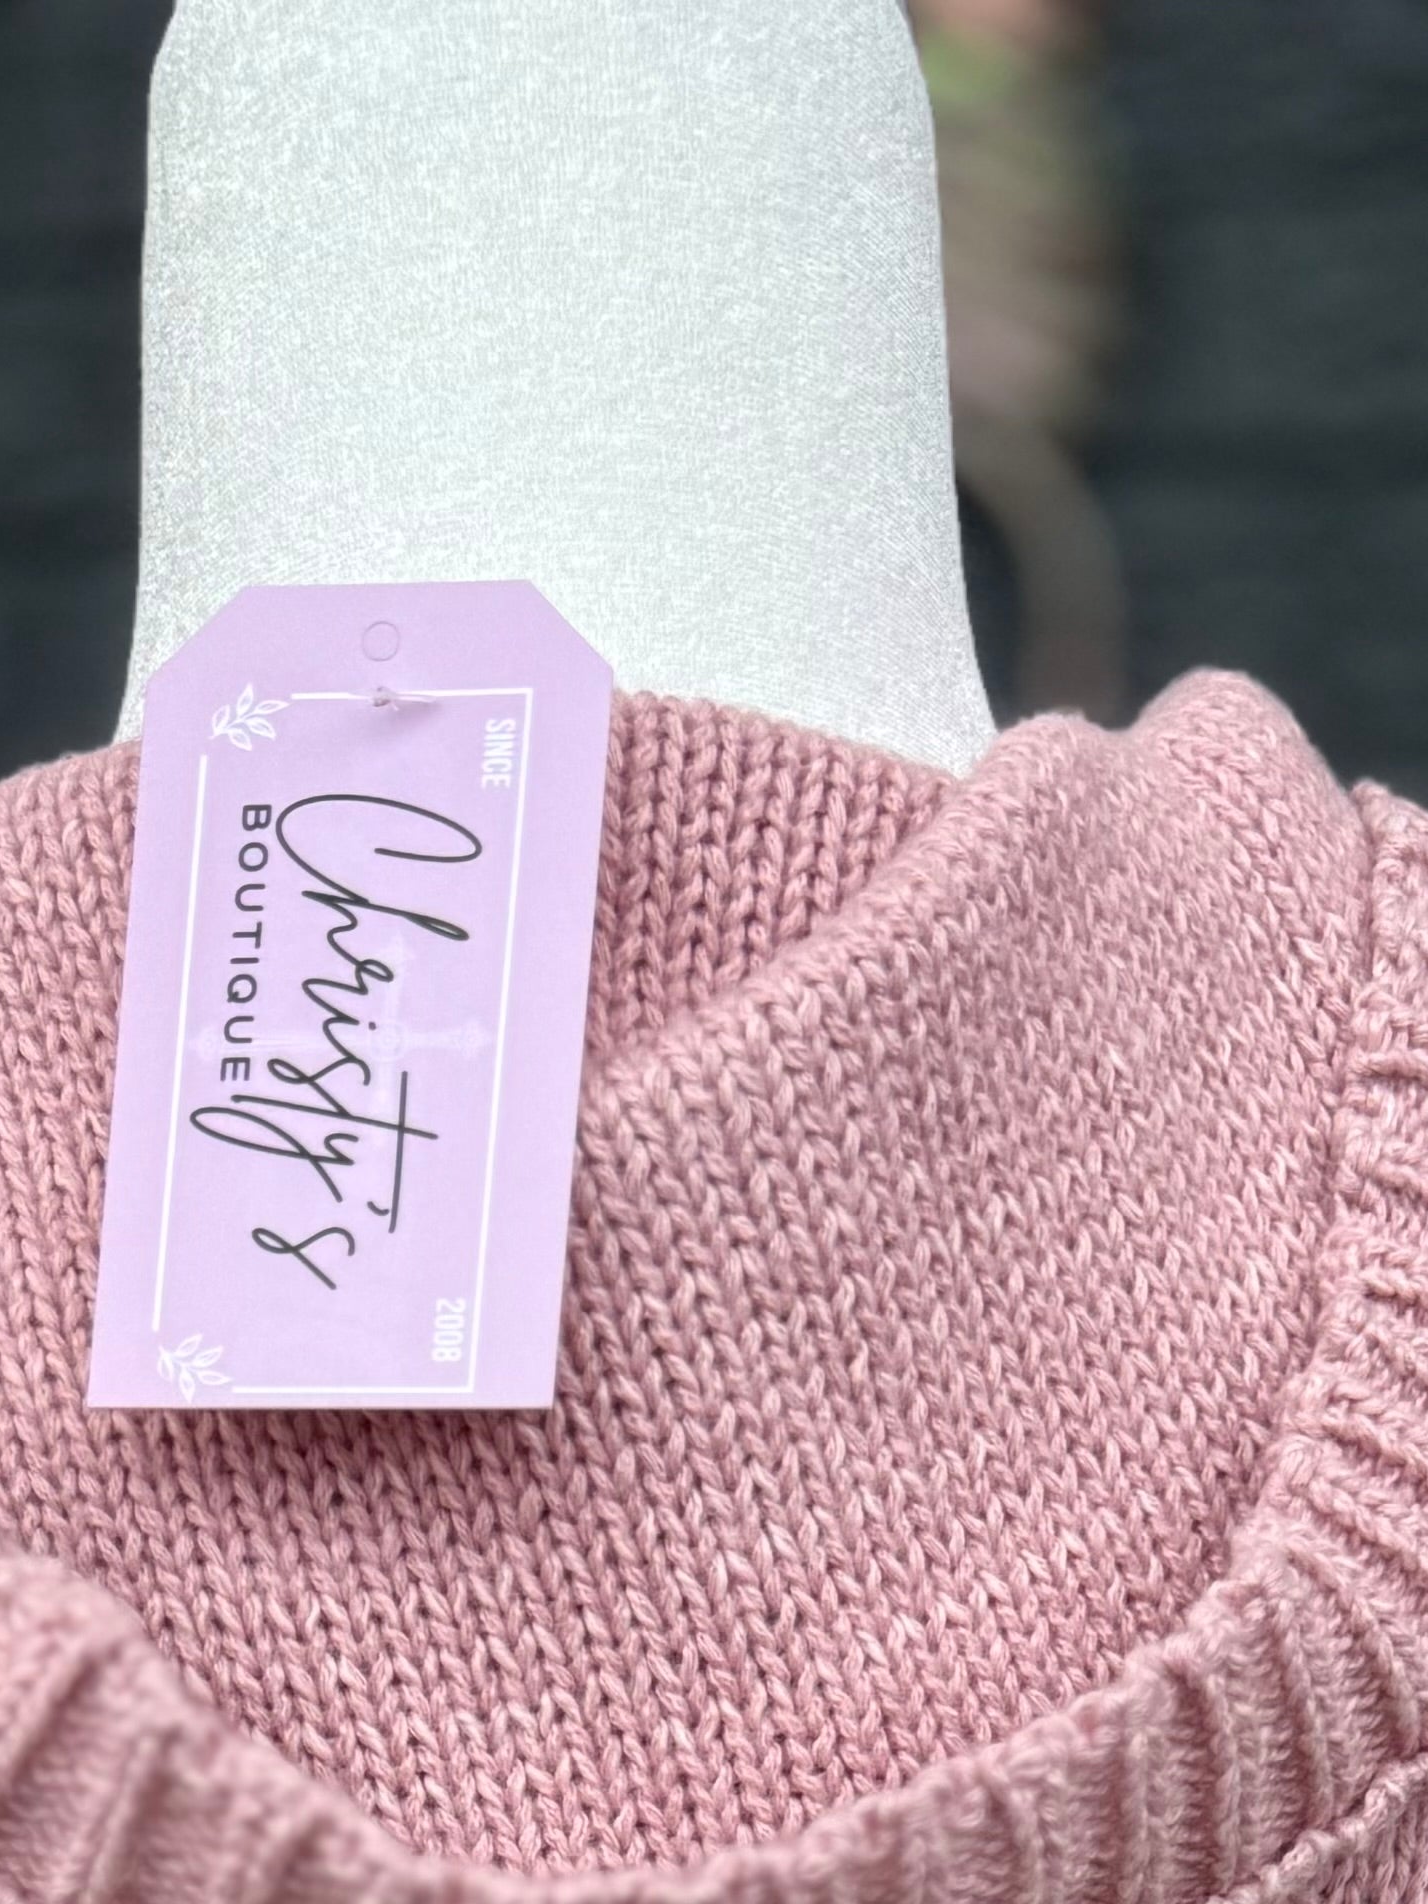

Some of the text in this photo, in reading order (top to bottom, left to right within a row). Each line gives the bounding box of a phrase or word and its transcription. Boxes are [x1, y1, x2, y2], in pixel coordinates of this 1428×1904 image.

[190, 793, 483, 1291] Christy's
[219, 803, 273, 1083] BOUTIQUE
[431, 718, 517, 1363] SINCE 2008
